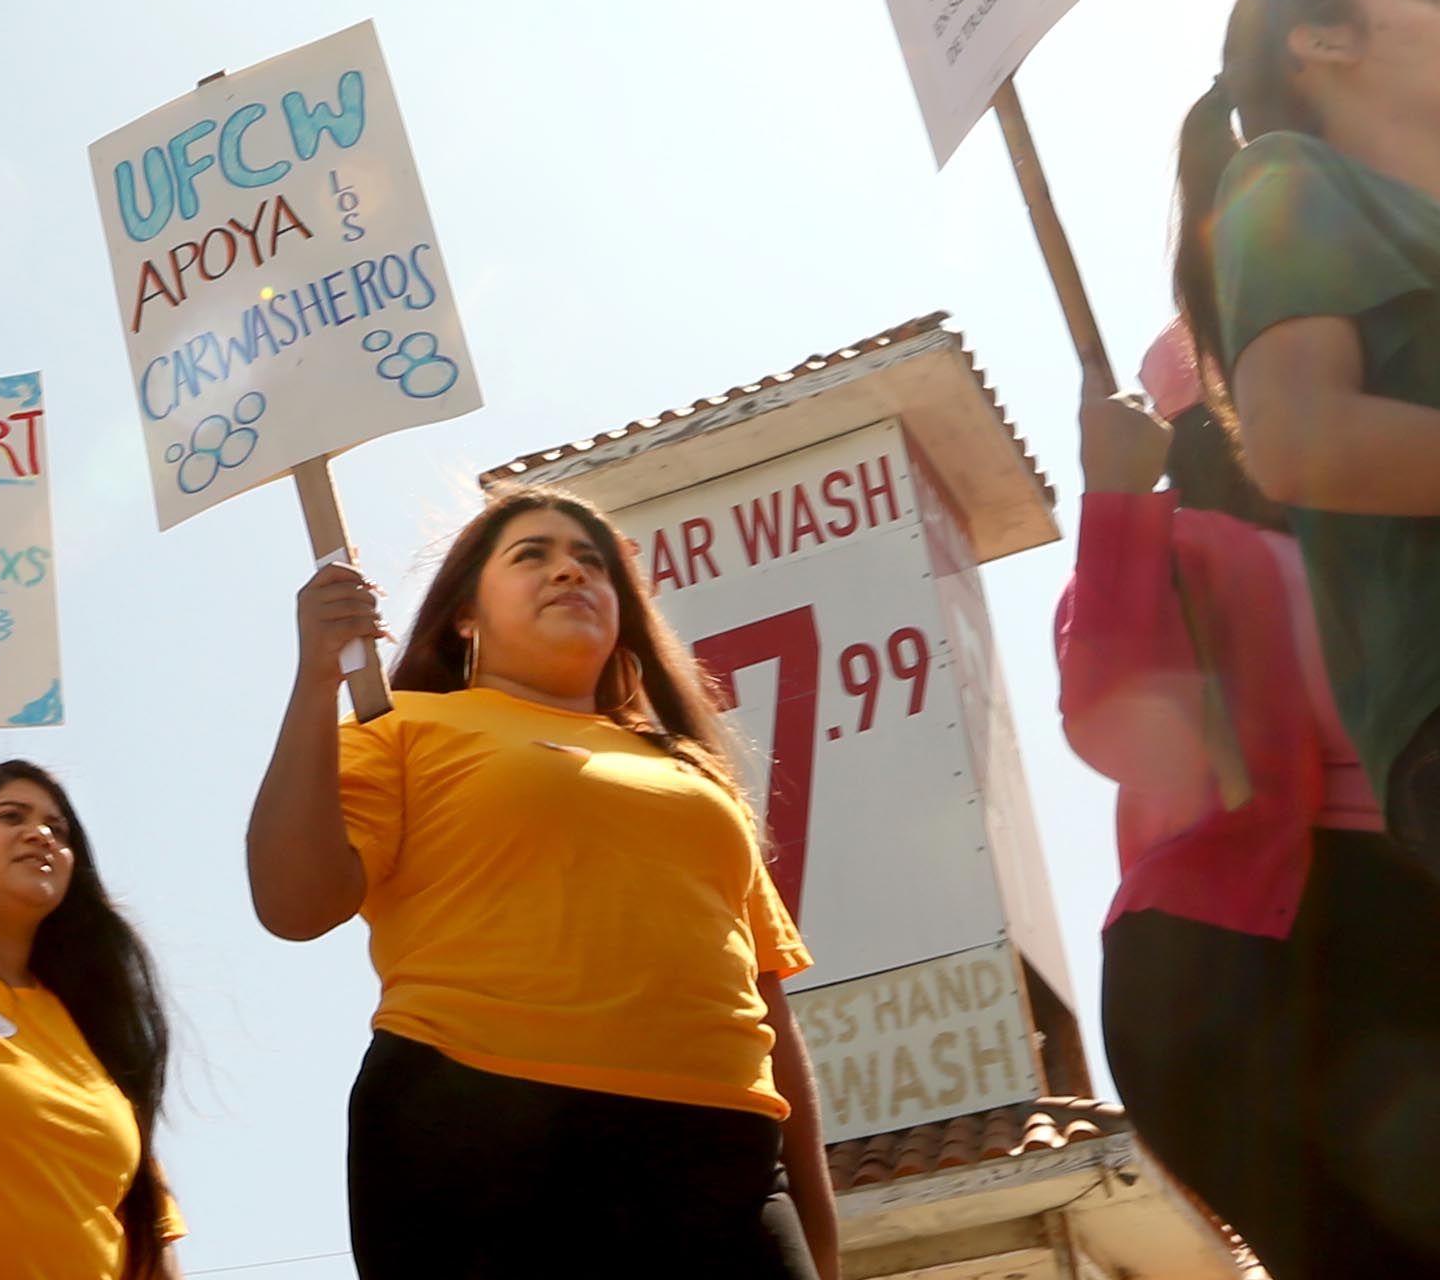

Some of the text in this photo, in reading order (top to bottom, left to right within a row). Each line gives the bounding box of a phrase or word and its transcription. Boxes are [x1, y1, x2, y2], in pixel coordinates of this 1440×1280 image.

[114, 70, 365, 242] UFCW
[129, 169, 366, 334] APOYA LOS
[139, 243, 437, 422] CARWASHEROS
[626, 454, 903, 598] AR WASH
[816, 1018, 1020, 1126] WASH
[872, 958, 1006, 1036] HAND
